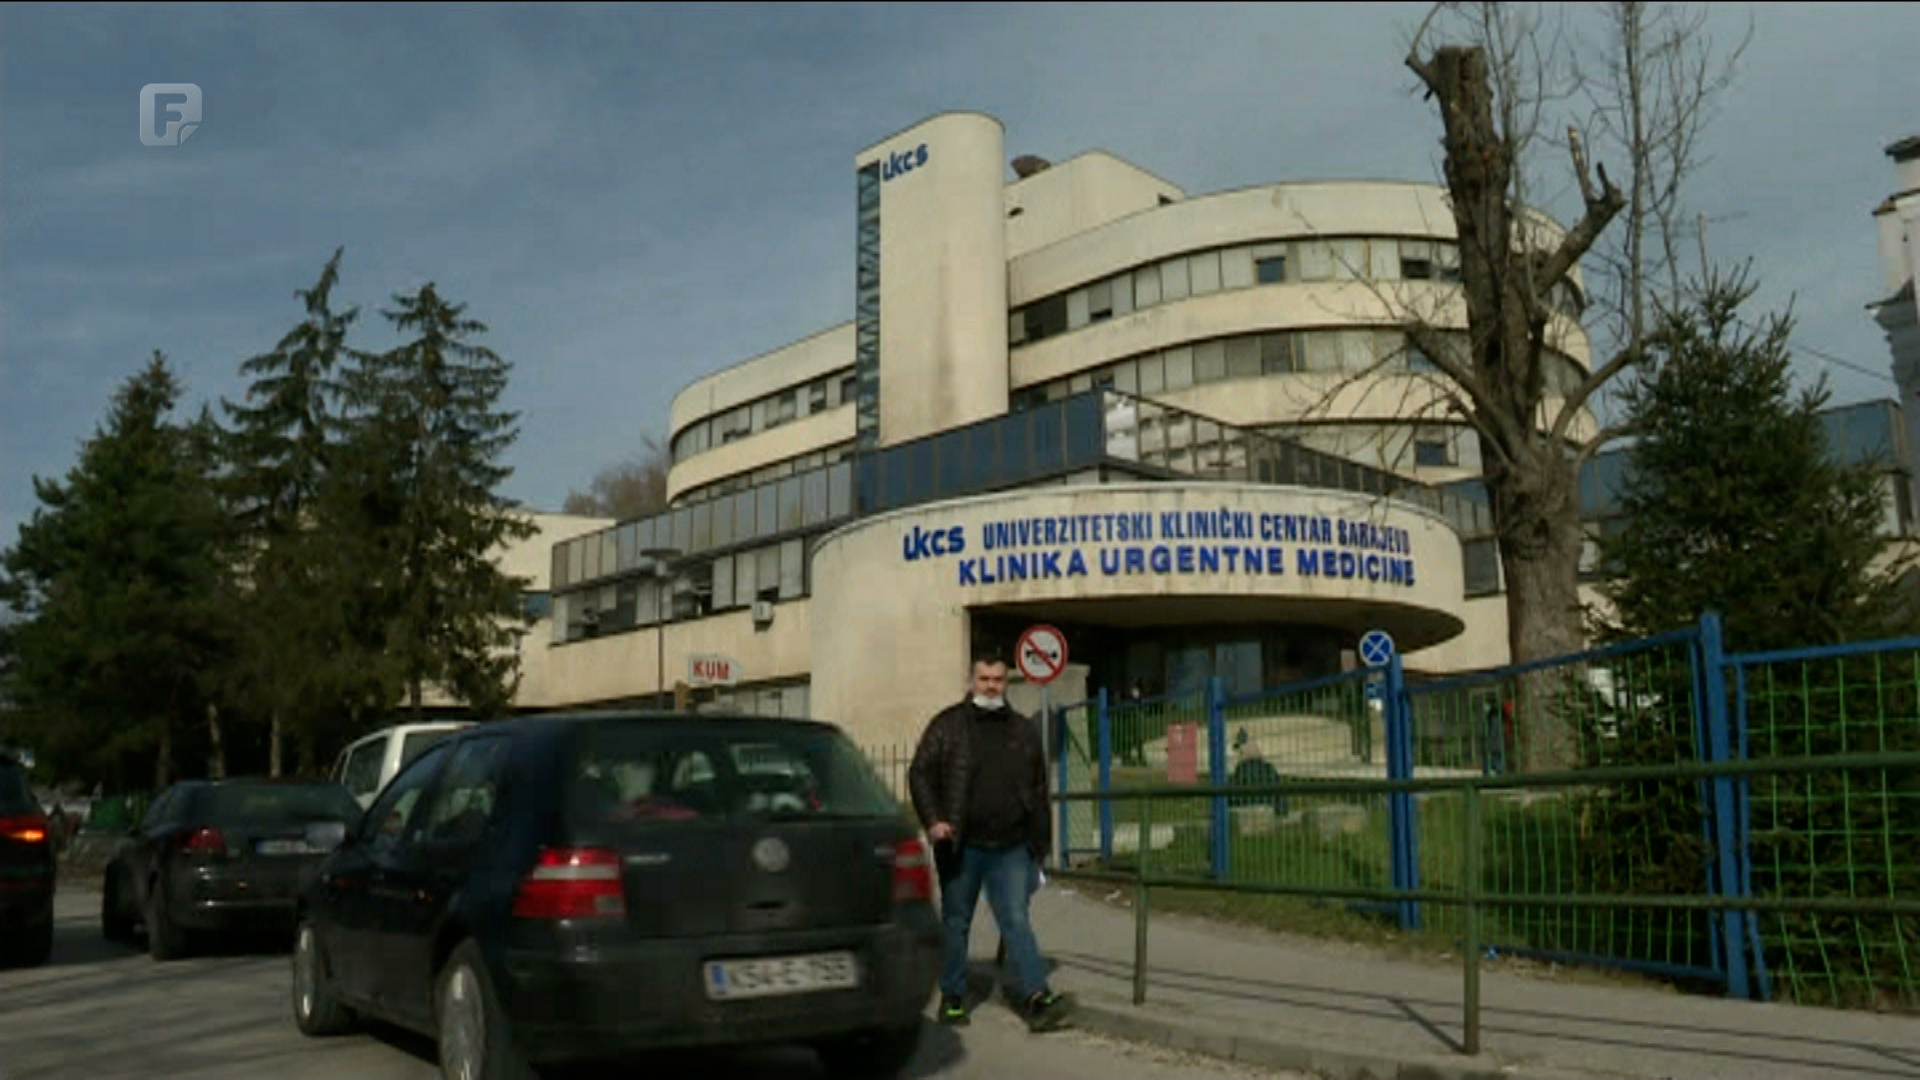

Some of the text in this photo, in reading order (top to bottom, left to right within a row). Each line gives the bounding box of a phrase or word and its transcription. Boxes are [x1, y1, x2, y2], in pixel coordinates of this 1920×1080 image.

[983, 507, 1411, 556] UNIVERZITETSKI KLINIČKI CENTAR SARAJEVO
[958, 545, 1415, 587] KLINIKA URGENTNE MEDICINE
[692, 660, 730, 680] KUM
